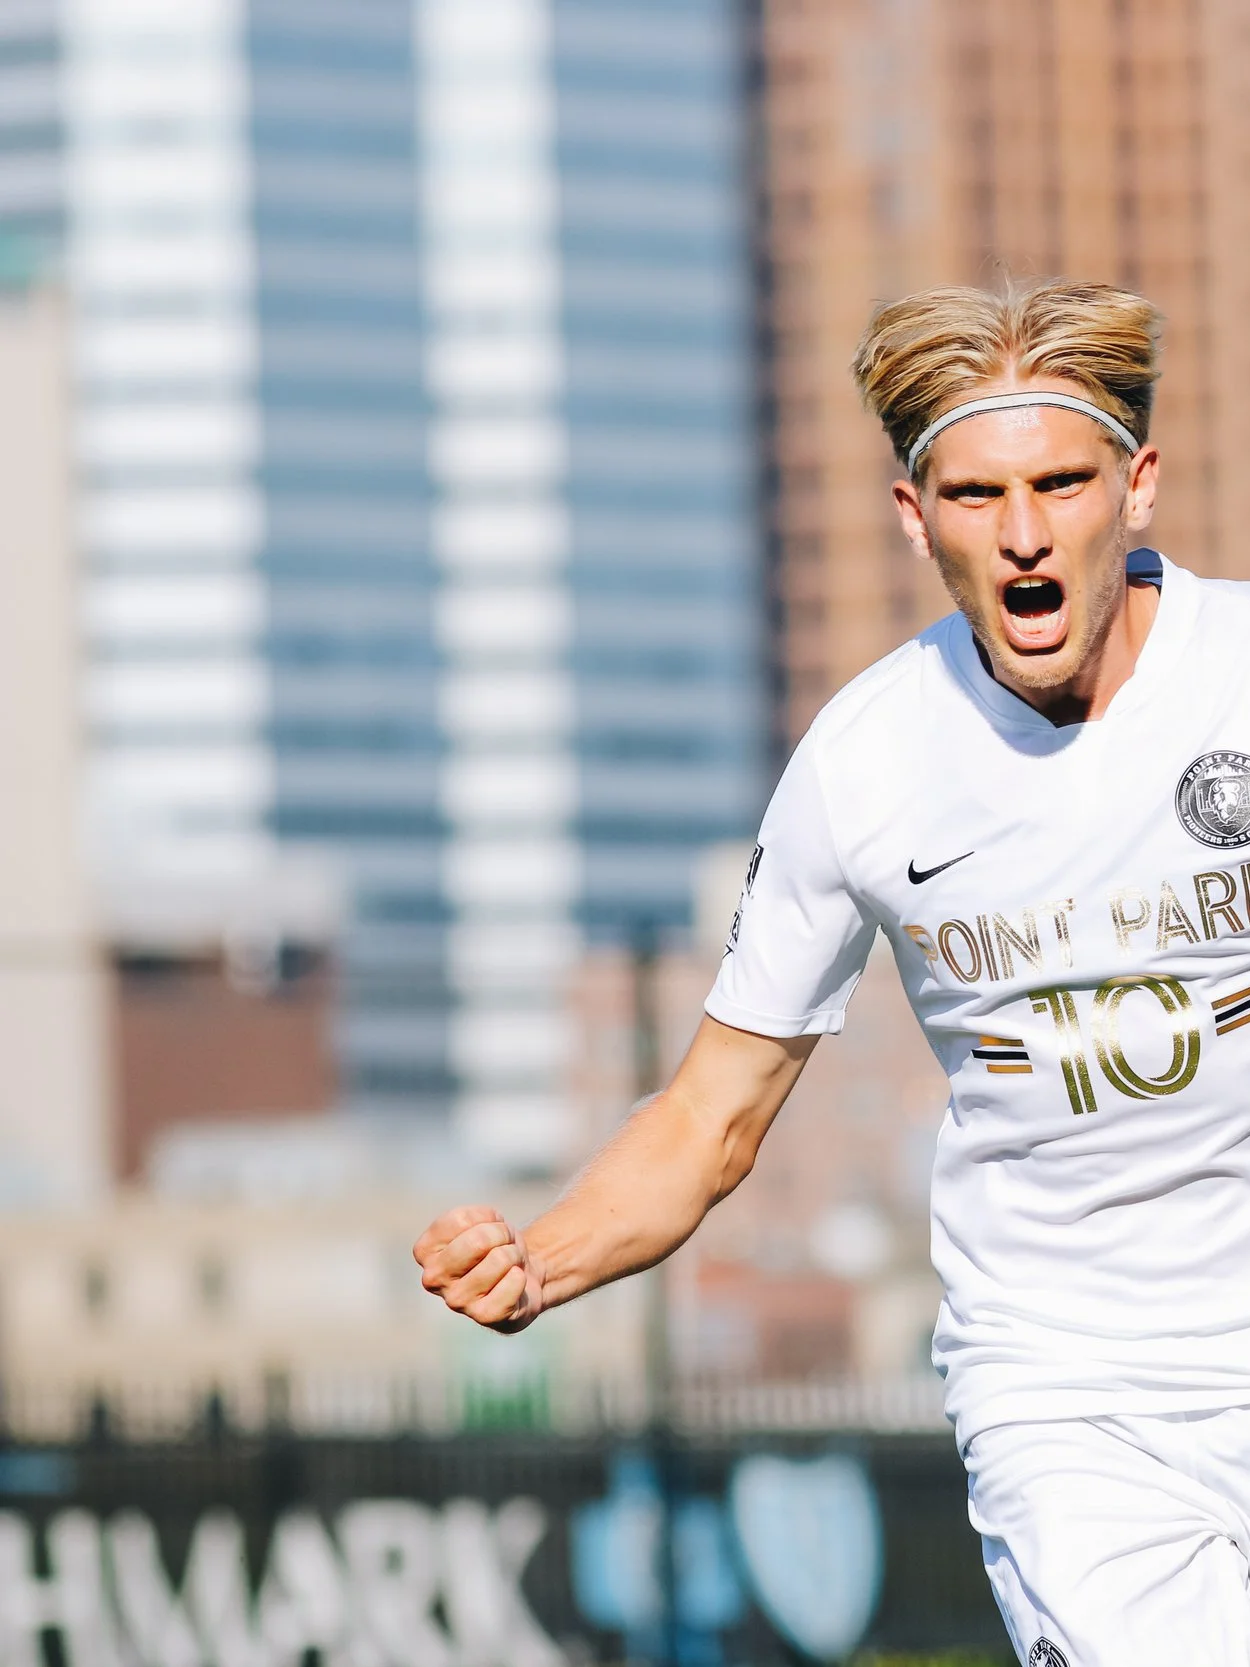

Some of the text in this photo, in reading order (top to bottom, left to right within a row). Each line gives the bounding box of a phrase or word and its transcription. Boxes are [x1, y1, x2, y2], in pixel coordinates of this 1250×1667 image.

[1186, 754, 1222, 781] POINT
[1183, 814, 1223, 845] PIONEERS
[903, 897, 1077, 985] POINT
[1028, 974, 1201, 1115] 10
